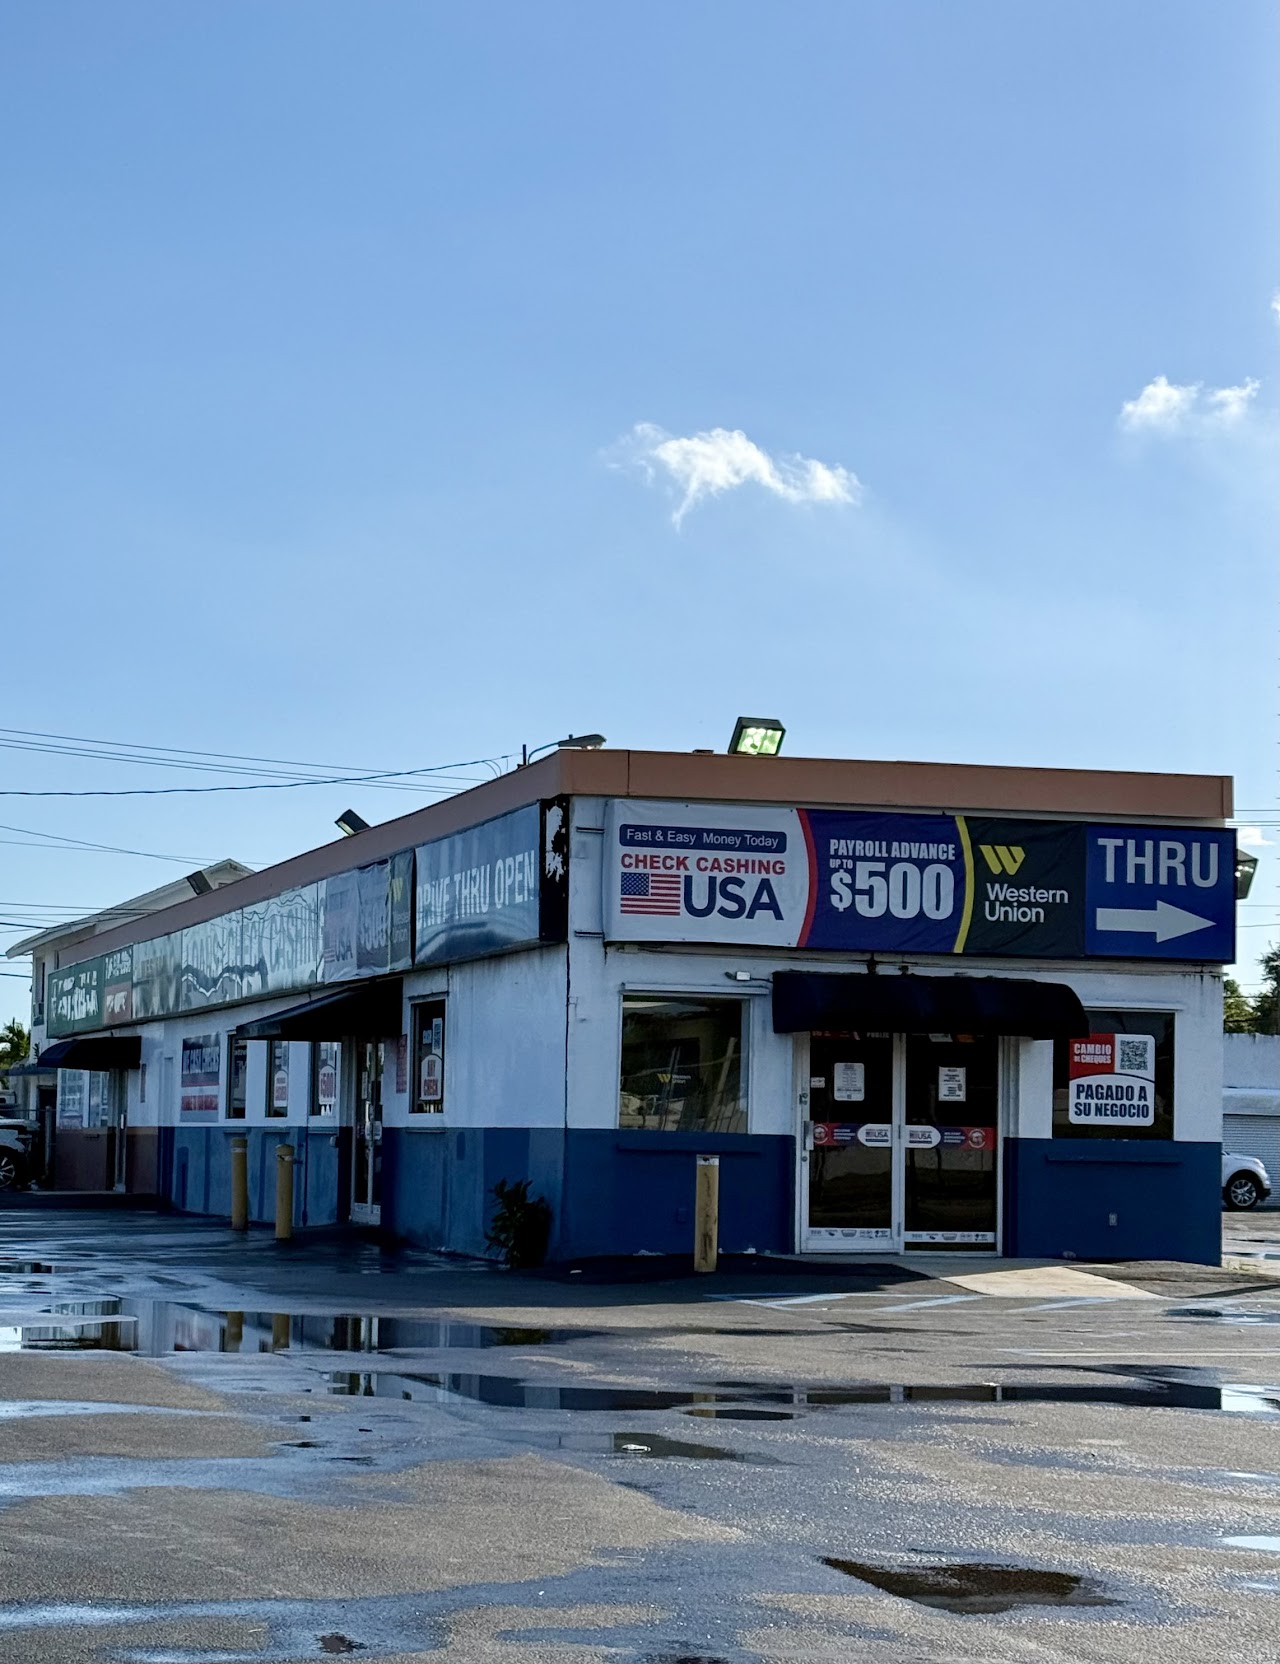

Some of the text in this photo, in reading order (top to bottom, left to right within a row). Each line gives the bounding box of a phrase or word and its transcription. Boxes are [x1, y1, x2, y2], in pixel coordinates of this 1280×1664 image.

[627, 828, 779, 849] Fast & Easy Money Today
[829, 839, 956, 860] PAYROLL ADVANCE
[621, 853, 785, 875] CHECK CASHING
[829, 858, 853, 869] UP TO
[1097, 838, 1219, 888] THRU
[454, 864, 490, 919] THRU
[494, 850, 535, 909] OPEN
[830, 861, 955, 920] $500
[986, 882, 1069, 904] Western
[683, 875, 785, 921] USA
[984, 901, 1045, 923] Union
[1074, 1043, 1112, 1055] CAMBIO
[1081, 1055, 1112, 1064] CHEQUES
[1076, 1084, 1148, 1102] PAGADO A
[1074, 1102, 1150, 1118] SU NEGOCIO
